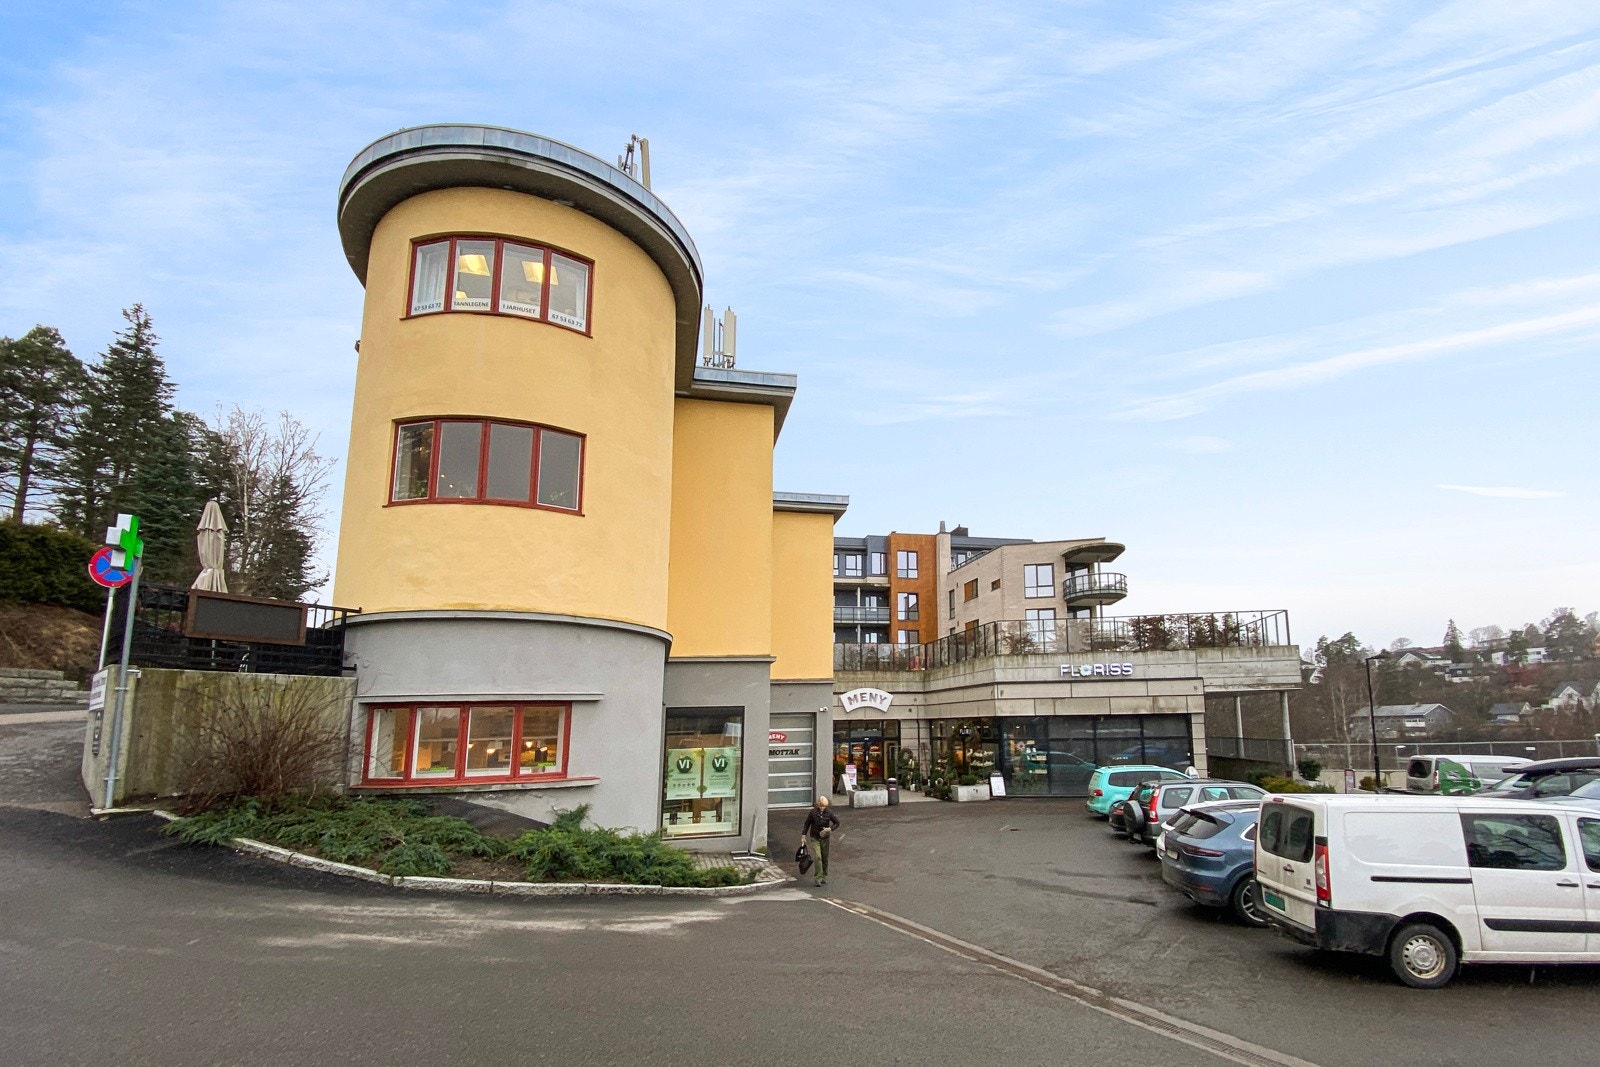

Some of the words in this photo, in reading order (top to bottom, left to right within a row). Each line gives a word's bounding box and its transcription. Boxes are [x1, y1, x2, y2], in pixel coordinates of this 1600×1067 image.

[506, 304, 536, 314] JARHUSET
[1060, 662, 1133, 677] FLORISS
[847, 692, 888, 706] MENY
[678, 759, 690, 769] VI
[714, 758, 725, 768] VI
